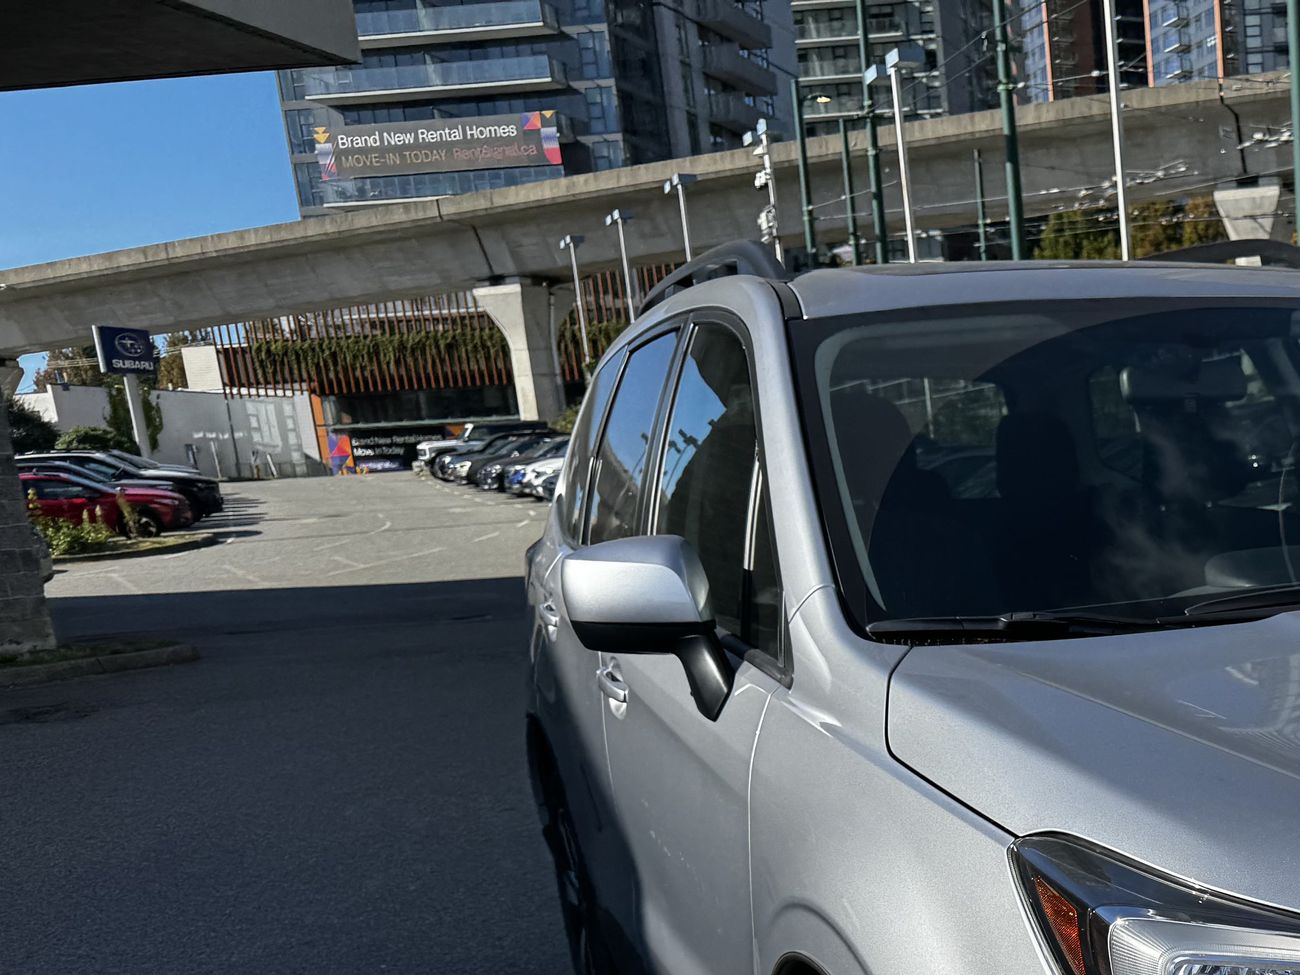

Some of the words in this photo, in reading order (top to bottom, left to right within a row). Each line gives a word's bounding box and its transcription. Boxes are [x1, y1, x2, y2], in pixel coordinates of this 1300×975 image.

[338, 131, 380, 149] Brand
[383, 131, 415, 146] New
[418, 125, 463, 143] Rental
[466, 124, 518, 140] Homes
[341, 152, 400, 168] MOVE-IN
[403, 149, 447, 164] TODAY
[112, 359, 154, 370] SUBARU
